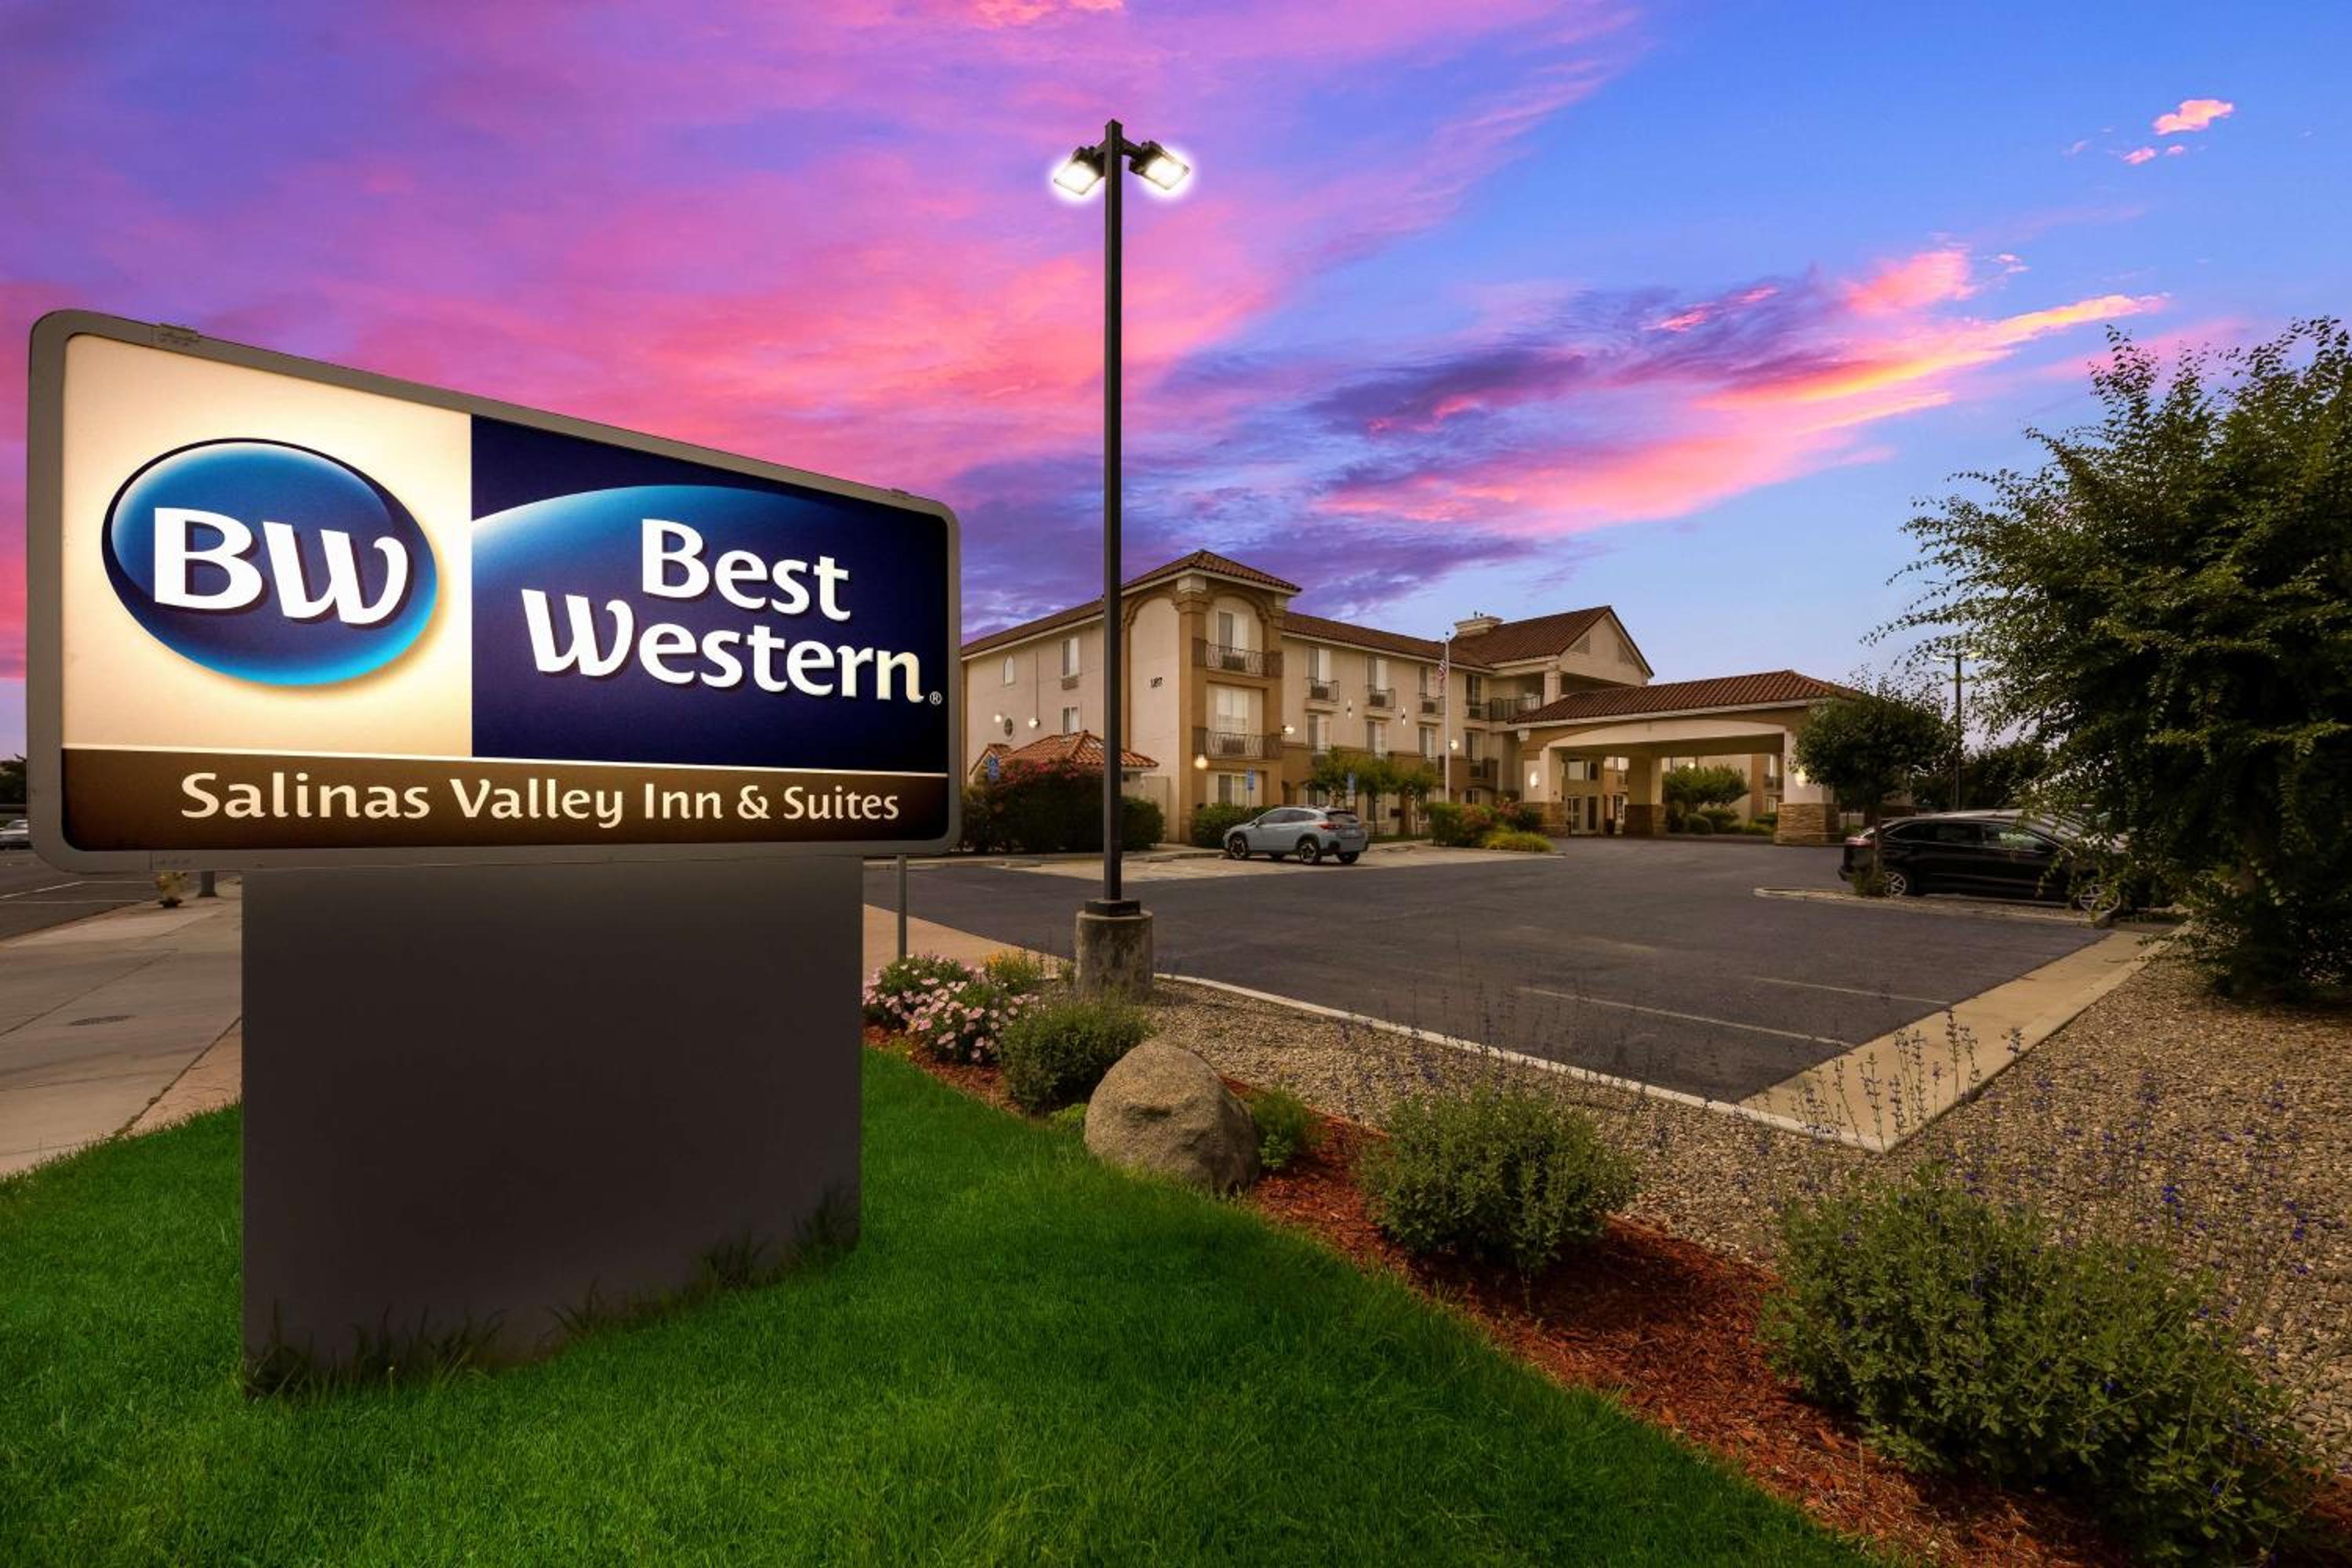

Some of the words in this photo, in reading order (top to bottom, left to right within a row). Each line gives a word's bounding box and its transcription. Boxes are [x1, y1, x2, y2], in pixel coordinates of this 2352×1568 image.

[154, 507, 408, 624] BW
[641, 518, 851, 621] Best
[521, 588, 924, 702] Western
[181, 771, 430, 819] Salinas
[449, 778, 623, 829] Valley
[644, 782, 724, 819] Inn
[737, 785, 771, 819] &
[784, 785, 899, 820] Suites
